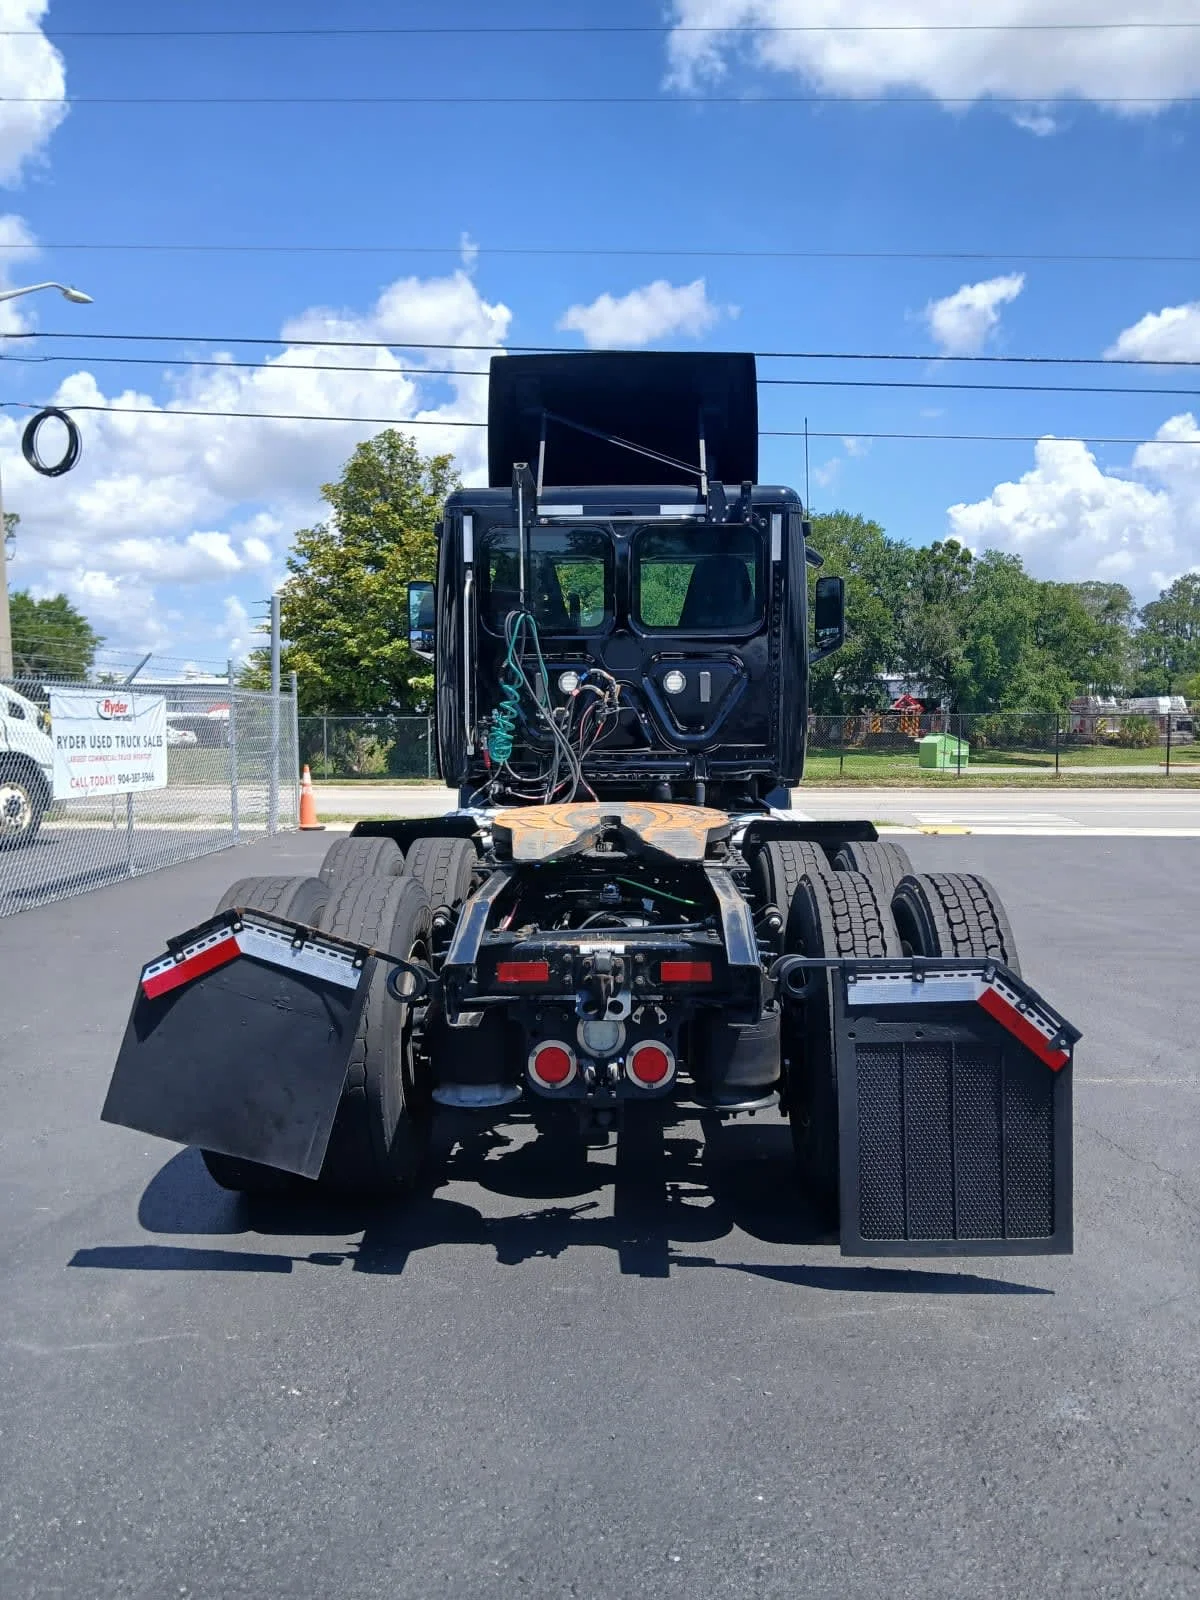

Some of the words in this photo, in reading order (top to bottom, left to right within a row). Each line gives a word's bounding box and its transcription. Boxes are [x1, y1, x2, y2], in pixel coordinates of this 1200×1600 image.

[104, 699, 128, 716] Ryder
[57, 735, 87, 749] RYDER
[90, 735, 112, 749] USED
[115, 735, 141, 748] TRUCK
[143, 735, 163, 747] SALES
[70, 776, 88, 788] CALL
[90, 774, 116, 786] TODAY!
